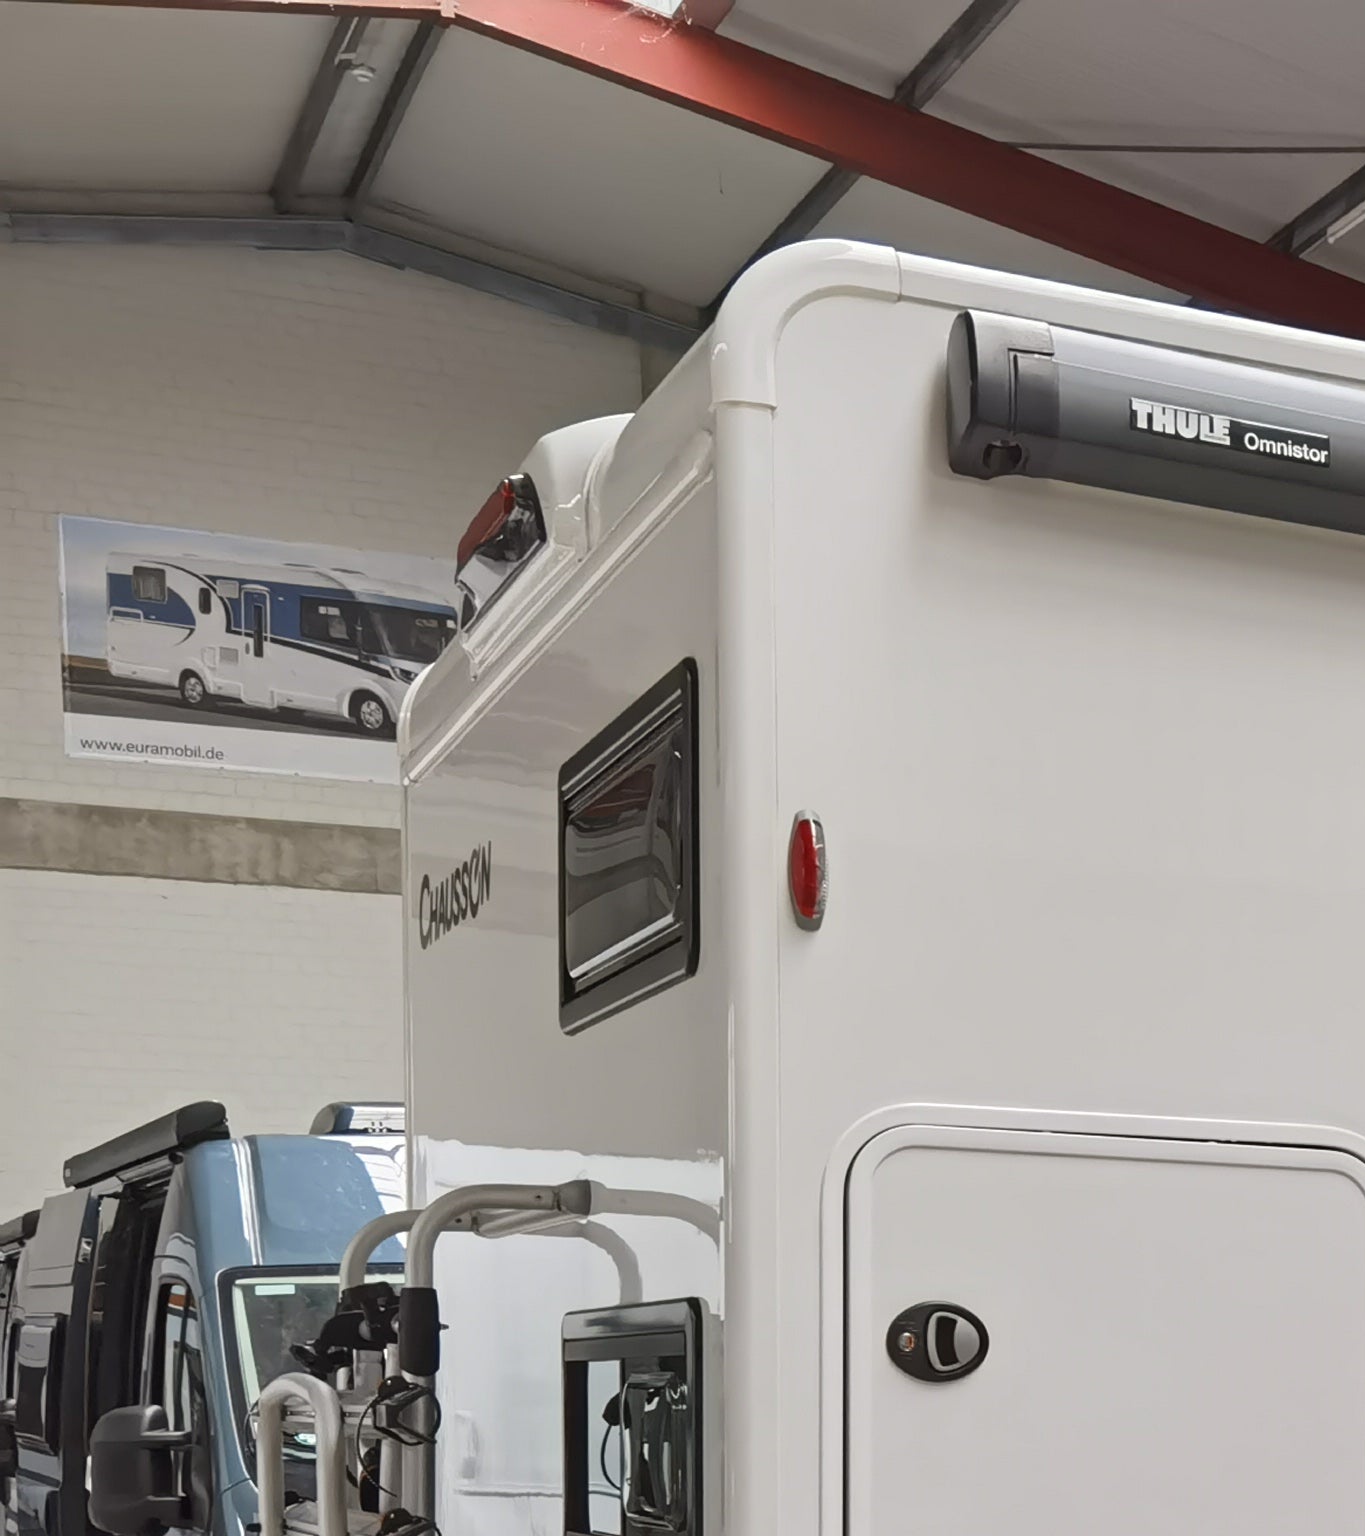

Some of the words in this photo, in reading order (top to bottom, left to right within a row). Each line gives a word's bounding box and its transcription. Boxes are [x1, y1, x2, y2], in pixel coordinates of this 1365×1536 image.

[1131, 400, 1230, 446] THULE
[1243, 432, 1329, 464] Omnistor
[79, 737, 225, 761] www.euramobil.de
